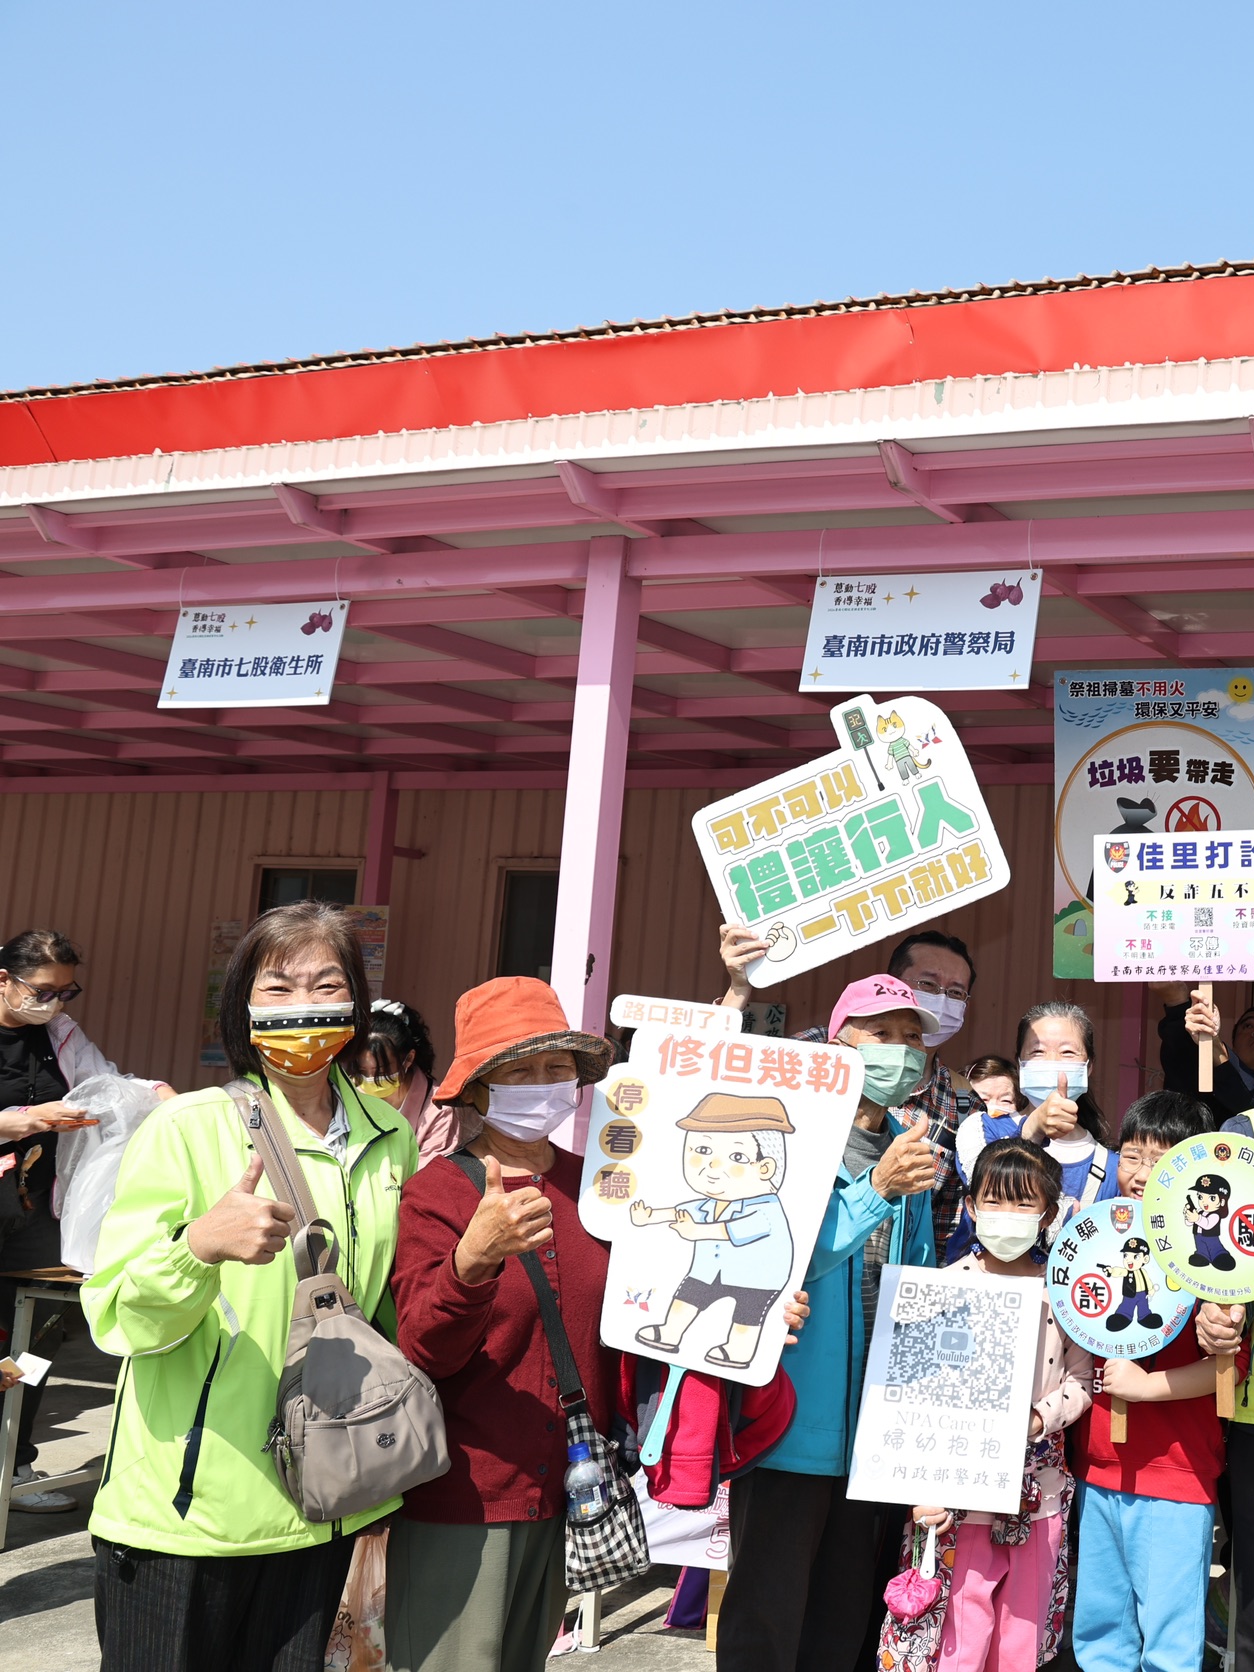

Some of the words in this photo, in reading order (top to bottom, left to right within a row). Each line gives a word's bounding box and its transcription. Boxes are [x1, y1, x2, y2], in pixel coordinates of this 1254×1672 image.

[821, 631, 1015, 658] 臺南市政府警察局
[178, 654, 324, 679] 臺南市七股衛生所
[1069, 680, 1186, 698] 祭祖掃墓不用火
[848, 713, 862, 726] 32
[1134, 701, 1219, 719] 環保又平安
[1088, 749, 1236, 789] 垃圾要帶走
[710, 763, 864, 851] 可不可以
[728, 781, 975, 922] 禮讓行人
[801, 842, 988, 940] 一下下就好
[1159, 882, 1249, 900] 反詐五不
[1143, 922, 1176, 931] 陌生來電
[1146, 909, 1173, 922] 不接
[1125, 938, 1152, 950] 不點
[1188, 950, 1221, 959] 個人資料
[1189, 936, 1220, 951] 不傳
[1123, 951, 1155, 960] 不明連結
[1110, 963, 1248, 977] 臺南市政府警察局佳里分局
[622, 1000, 731, 1032] 路口到了！
[657, 1034, 851, 1095] 修但幾勒
[1052, 1217, 1099, 1286] 反詐騙
[1079, 1282, 1105, 1309] 詐
[936, 1350, 970, 1363] YouTube
[896, 1411, 933, 1428] NPA
[939, 1414, 976, 1432] Care
[983, 1418, 995, 1433] U
[883, 1429, 1001, 1459] 婦幼抱抱
[892, 1465, 1010, 1489] 內政部警政署
